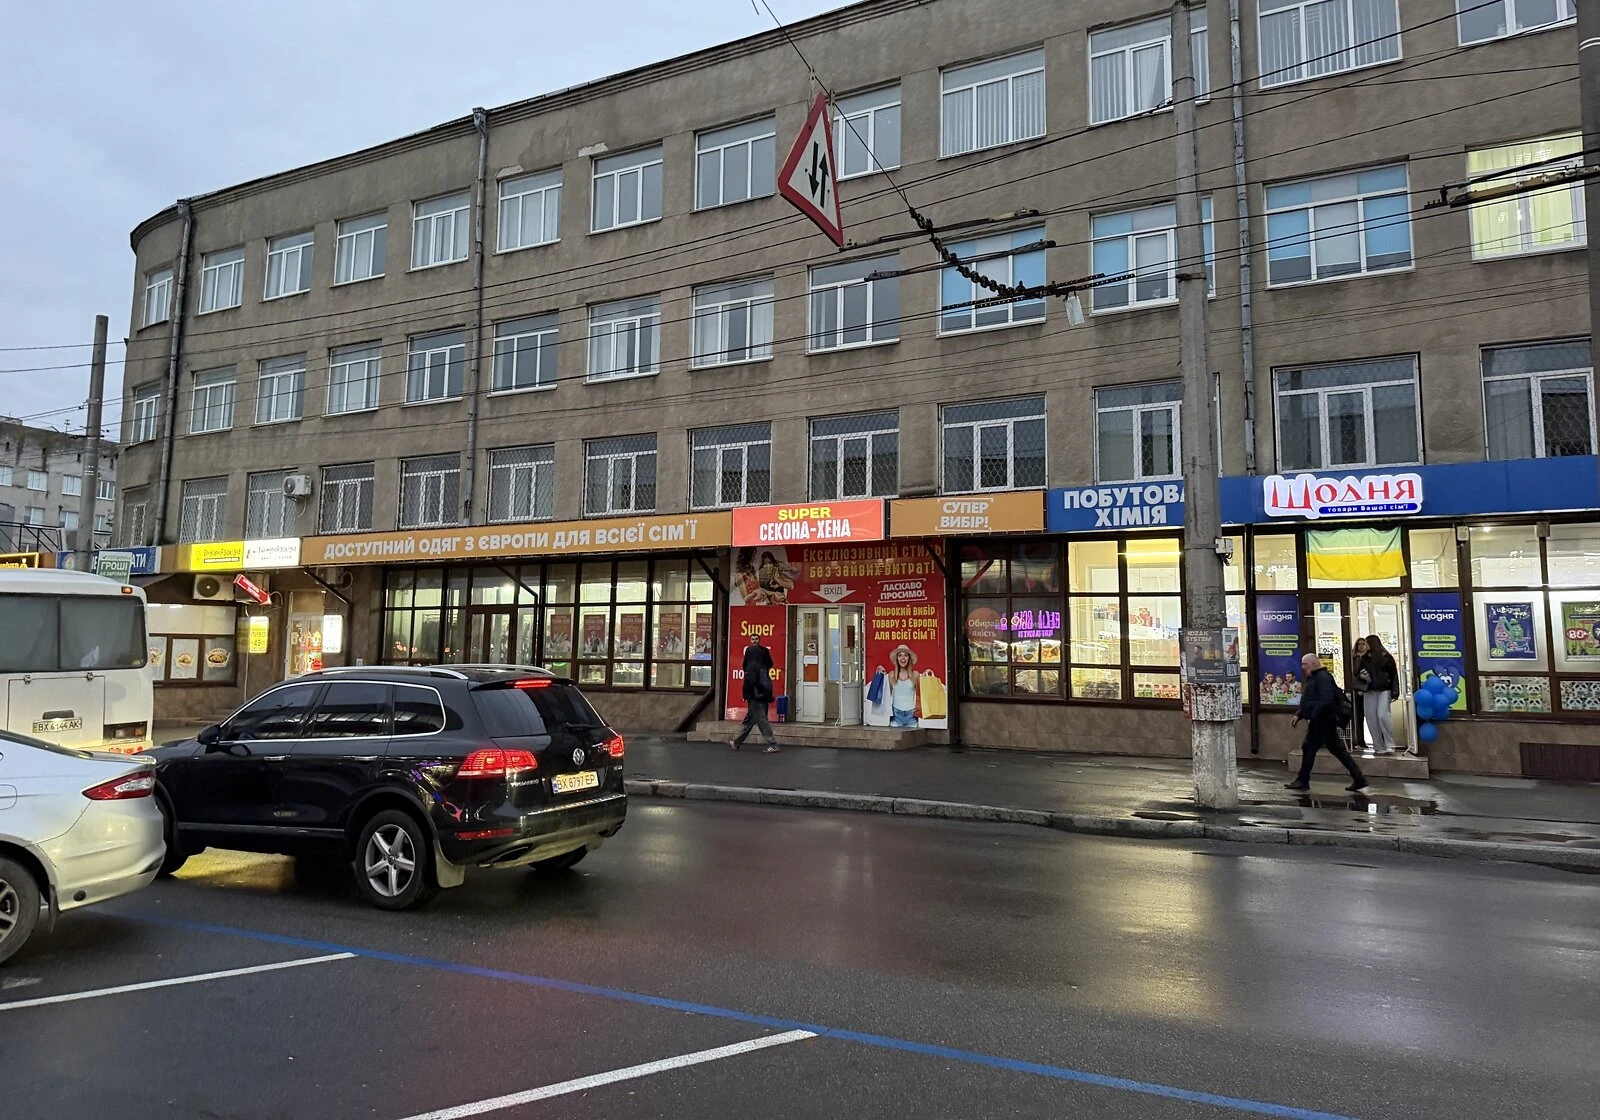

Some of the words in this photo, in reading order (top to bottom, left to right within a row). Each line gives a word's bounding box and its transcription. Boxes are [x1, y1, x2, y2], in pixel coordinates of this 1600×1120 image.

[943, 502, 988, 513] СУПЕР
[778, 507, 831, 520] SUPER
[1095, 505, 1167, 527] ХІМІЯ
[941, 516, 988, 528] ВИБІР!
[324, 537, 415, 559] ДОСТУПНИЙ
[419, 537, 461, 555] ОДЯГ
[464, 536, 475, 551] З
[479, 532, 548, 550] ЄВРОПИ
[553, 530, 590, 549] ДЛЯ
[595, 522, 645, 544] ВСІЄЇ
[100, 562, 127, 570] ГРОШІ
[824, 586, 843, 595] ВХІД
[882, 581, 922, 591] ЛАСКАВО
[880, 590, 925, 600] ПРОСИМО!
[741, 620, 775, 636] Super
[38, 722, 49, 731] BX
[69, 720, 80, 729] AK
[557, 778, 568, 789] BX
